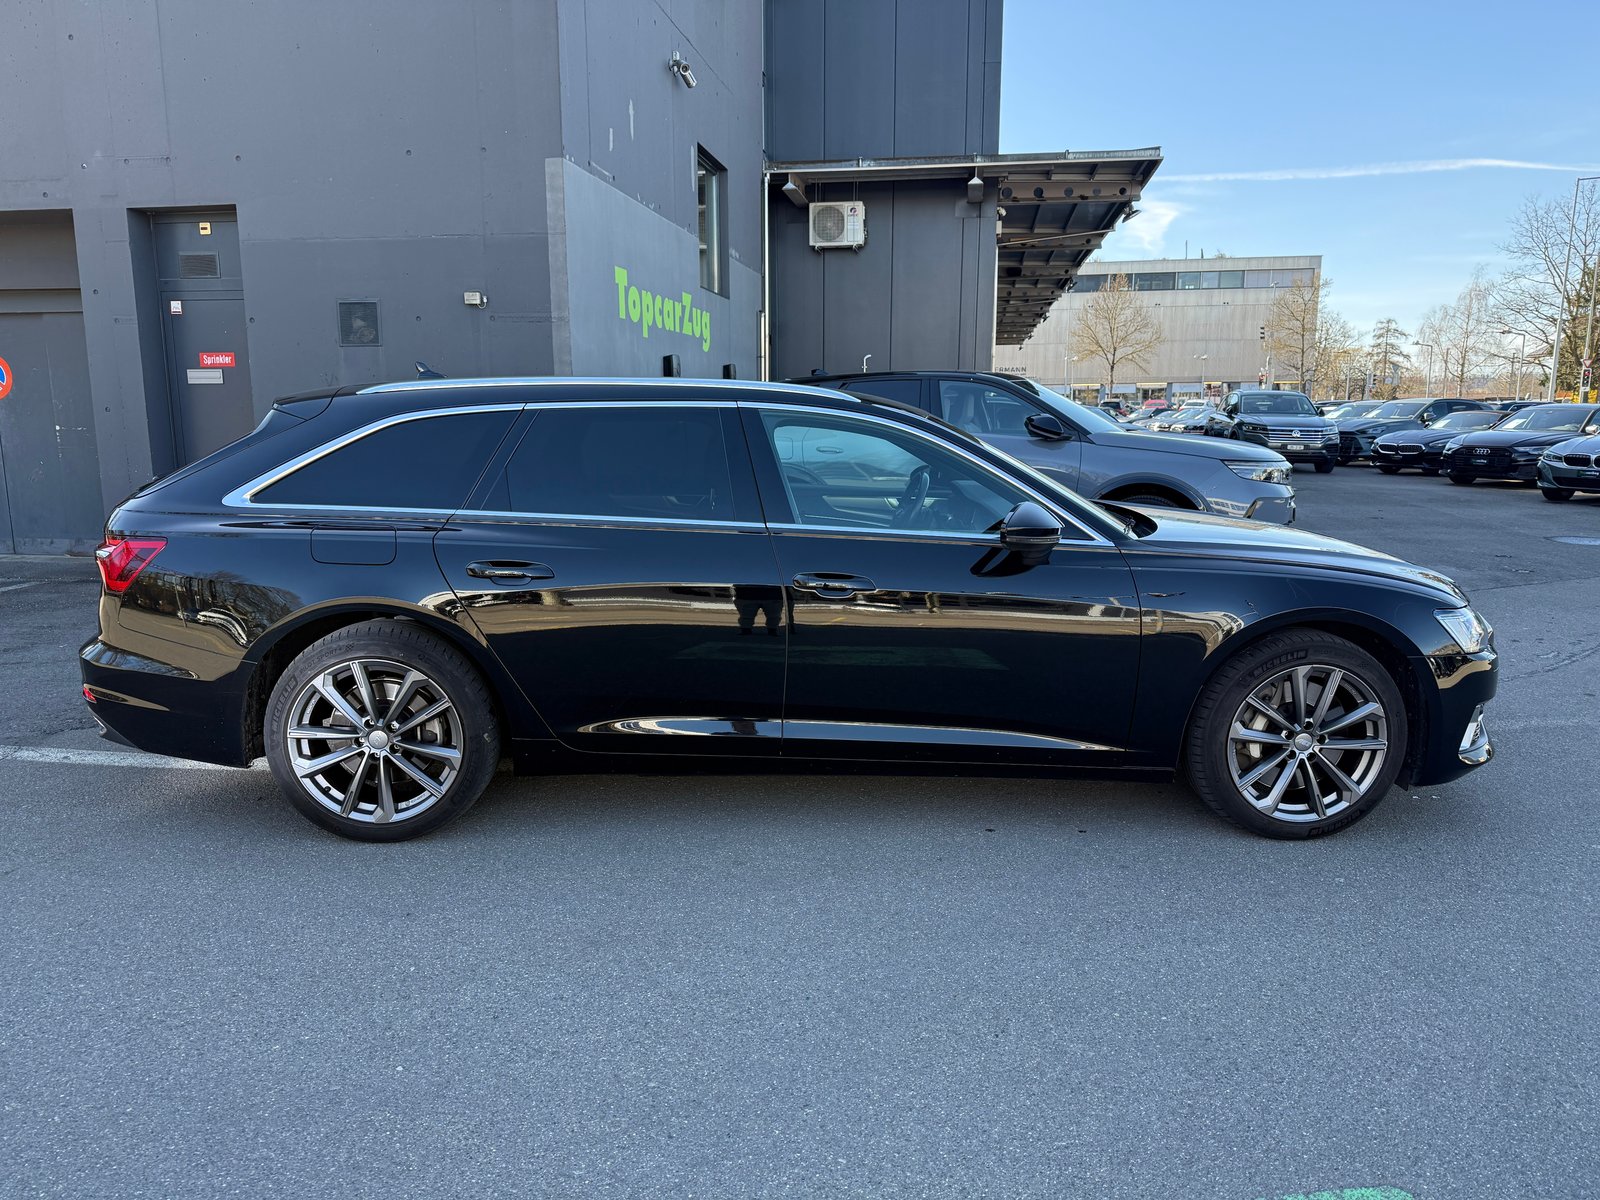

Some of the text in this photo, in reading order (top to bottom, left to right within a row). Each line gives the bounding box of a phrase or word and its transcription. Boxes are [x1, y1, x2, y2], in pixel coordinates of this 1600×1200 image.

[614, 265, 711, 352] TopcarZug
[202, 354, 232, 365] Sprinkler
[1254, 650, 1306, 676] MICHELIN
[272, 677, 297, 729] MICHELIN
